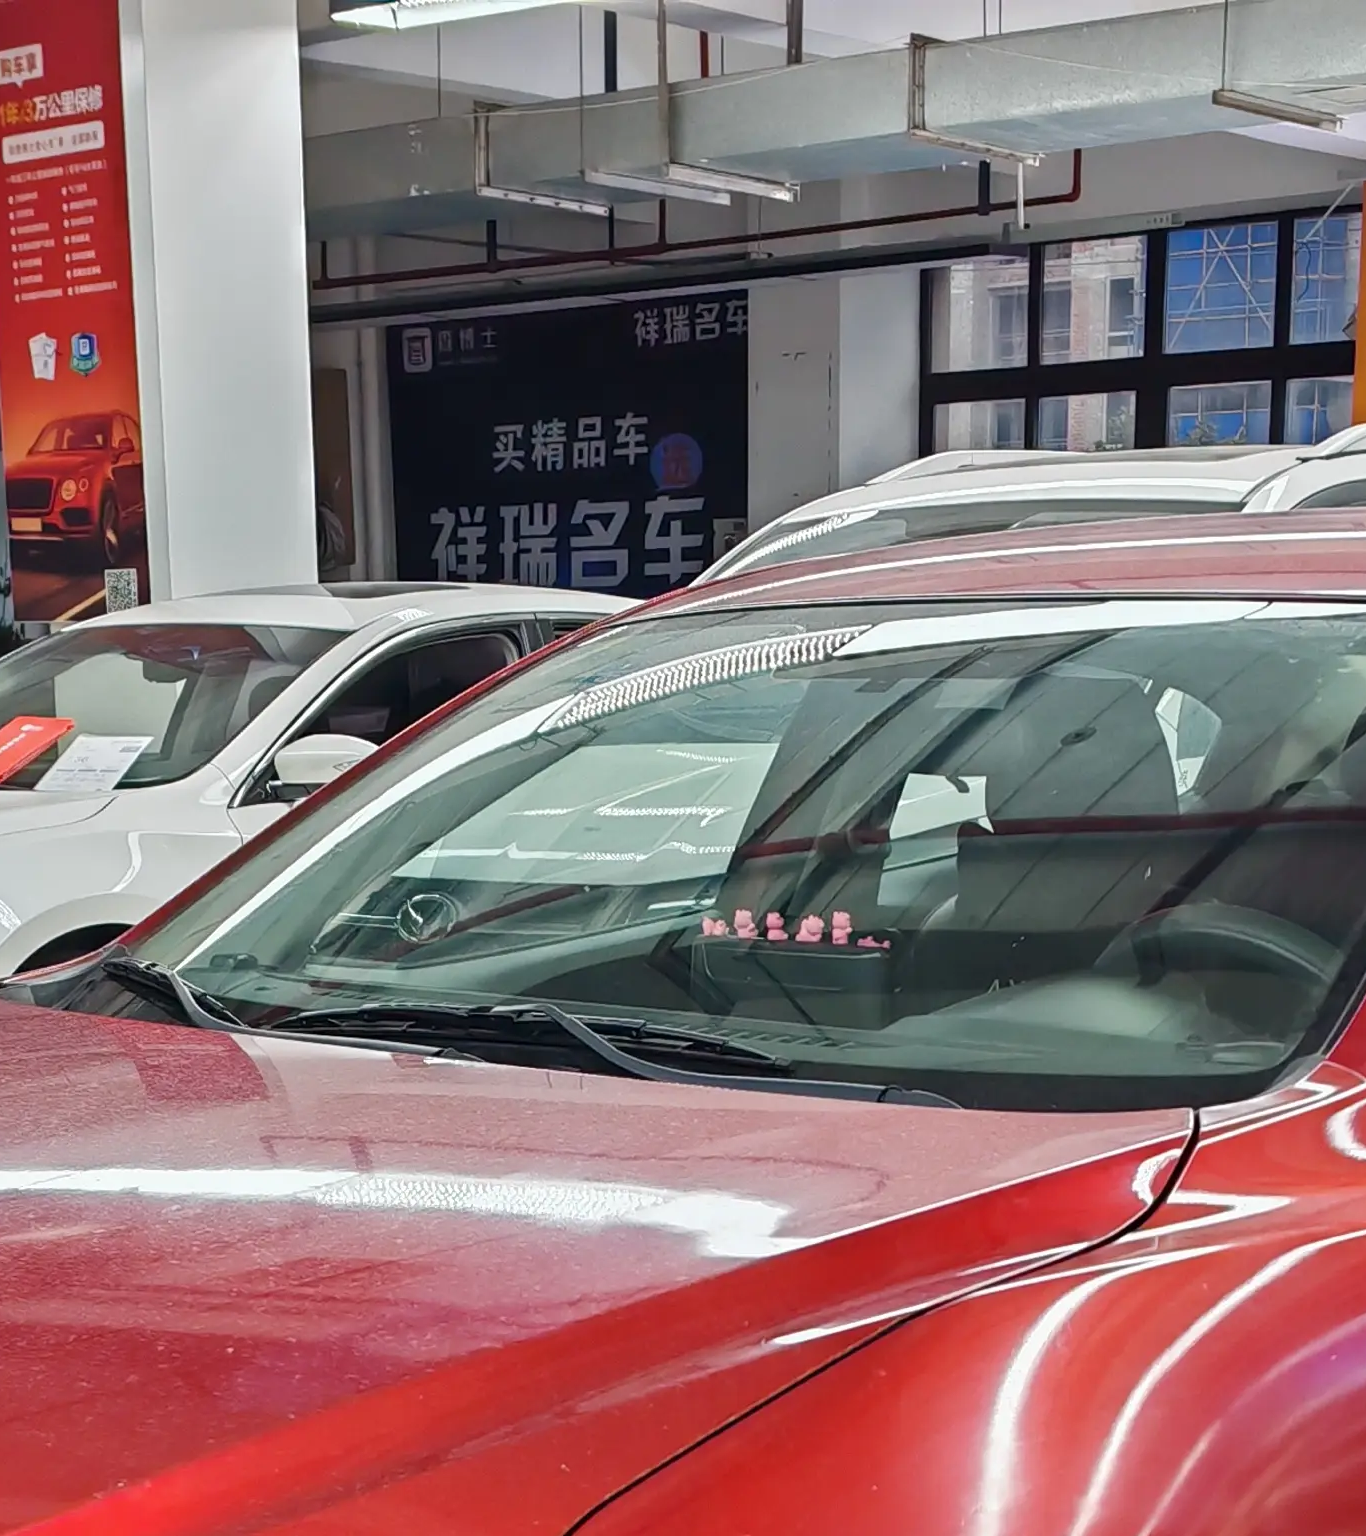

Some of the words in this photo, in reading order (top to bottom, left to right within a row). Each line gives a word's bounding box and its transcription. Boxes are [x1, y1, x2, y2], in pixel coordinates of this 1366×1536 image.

[633, 299, 747, 348] 祥瑞名车
[492, 411, 650, 474] 买精品车
[430, 496, 705, 586] 祥瑞名车
